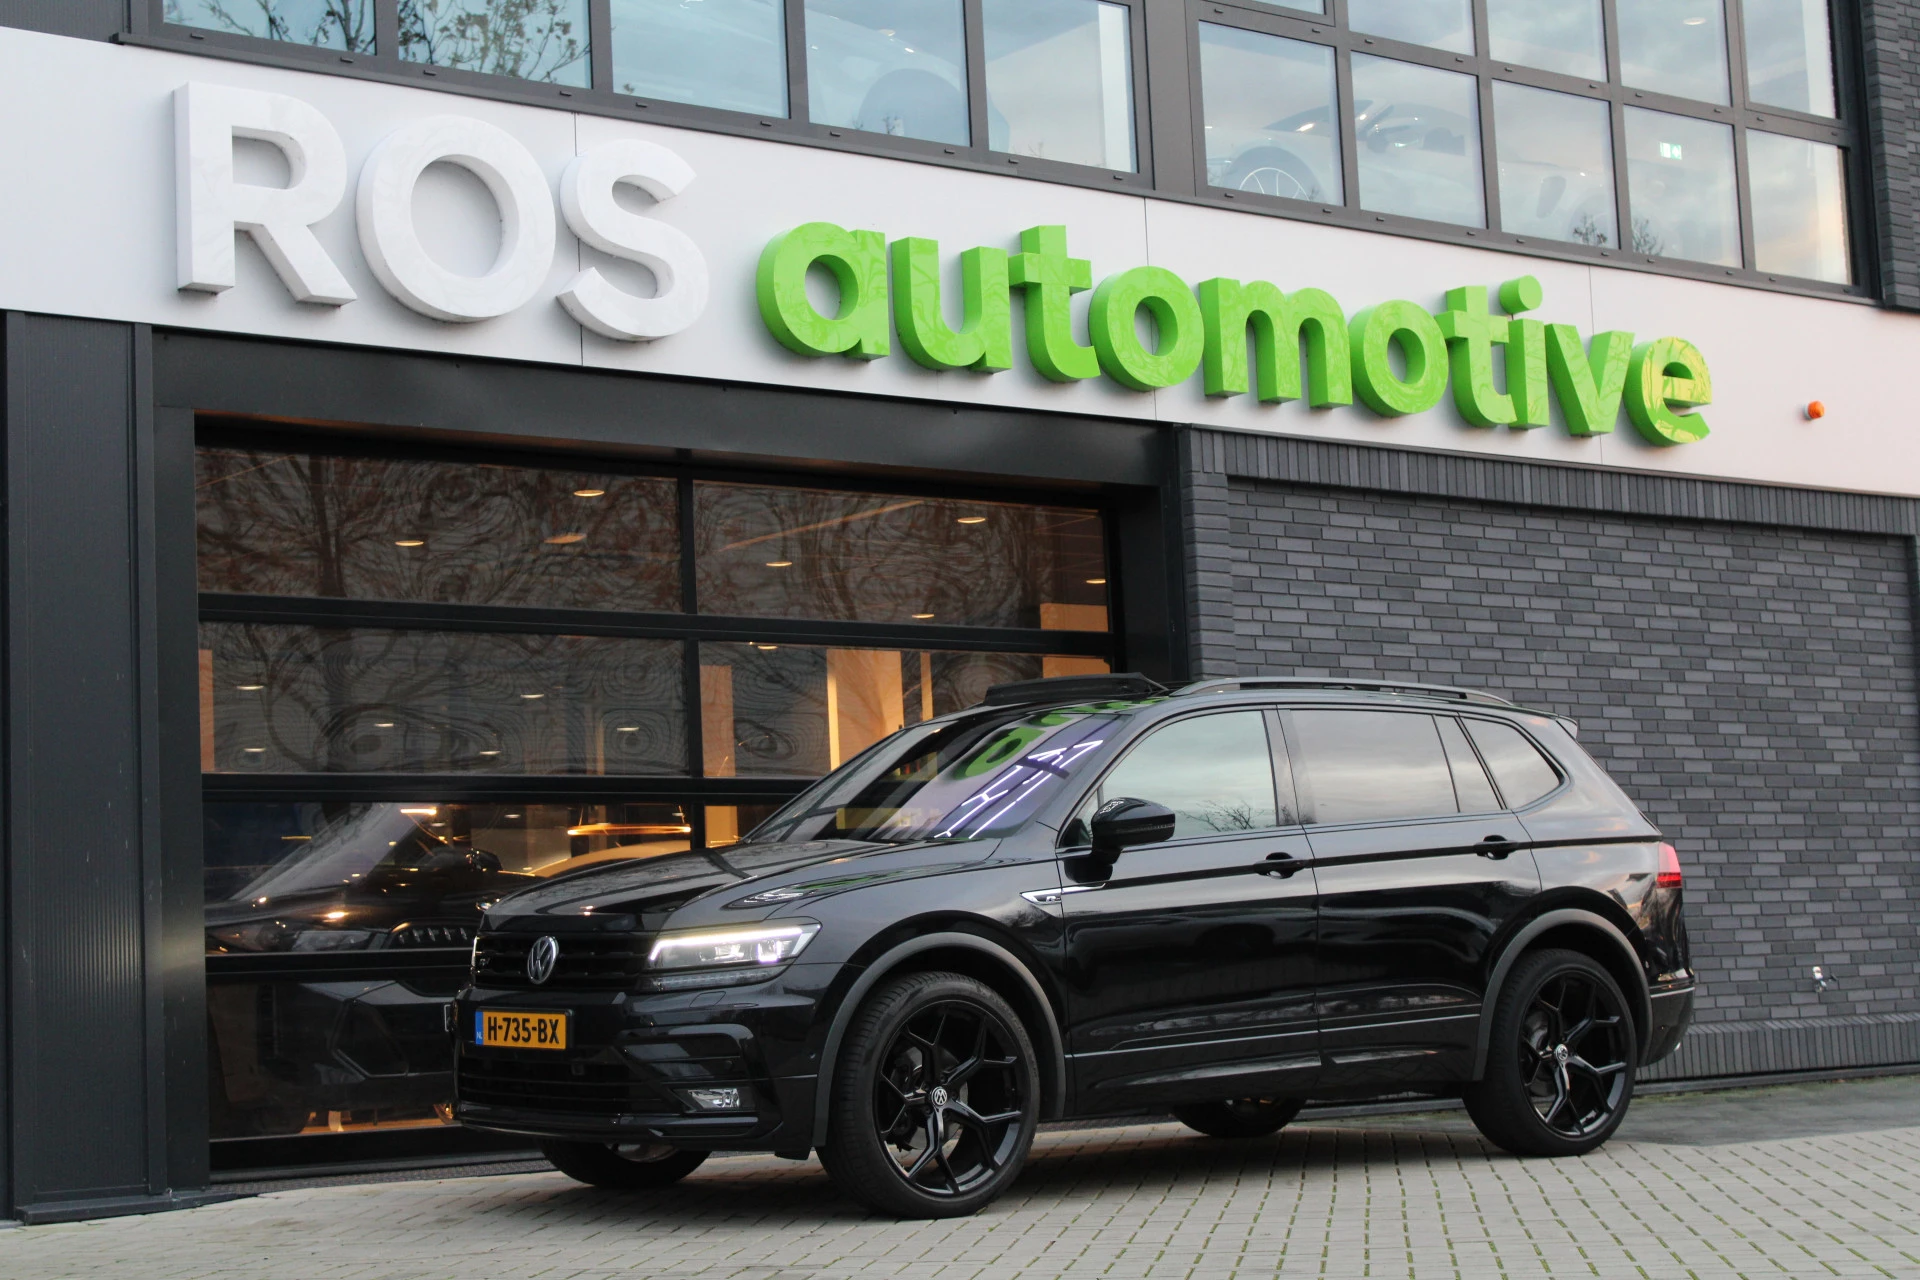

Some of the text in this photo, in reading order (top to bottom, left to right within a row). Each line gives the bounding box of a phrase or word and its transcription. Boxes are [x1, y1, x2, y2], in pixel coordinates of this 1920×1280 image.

[174, 81, 1711, 447] ROS automotive
[487, 1016, 560, 1044] H-735-BX
